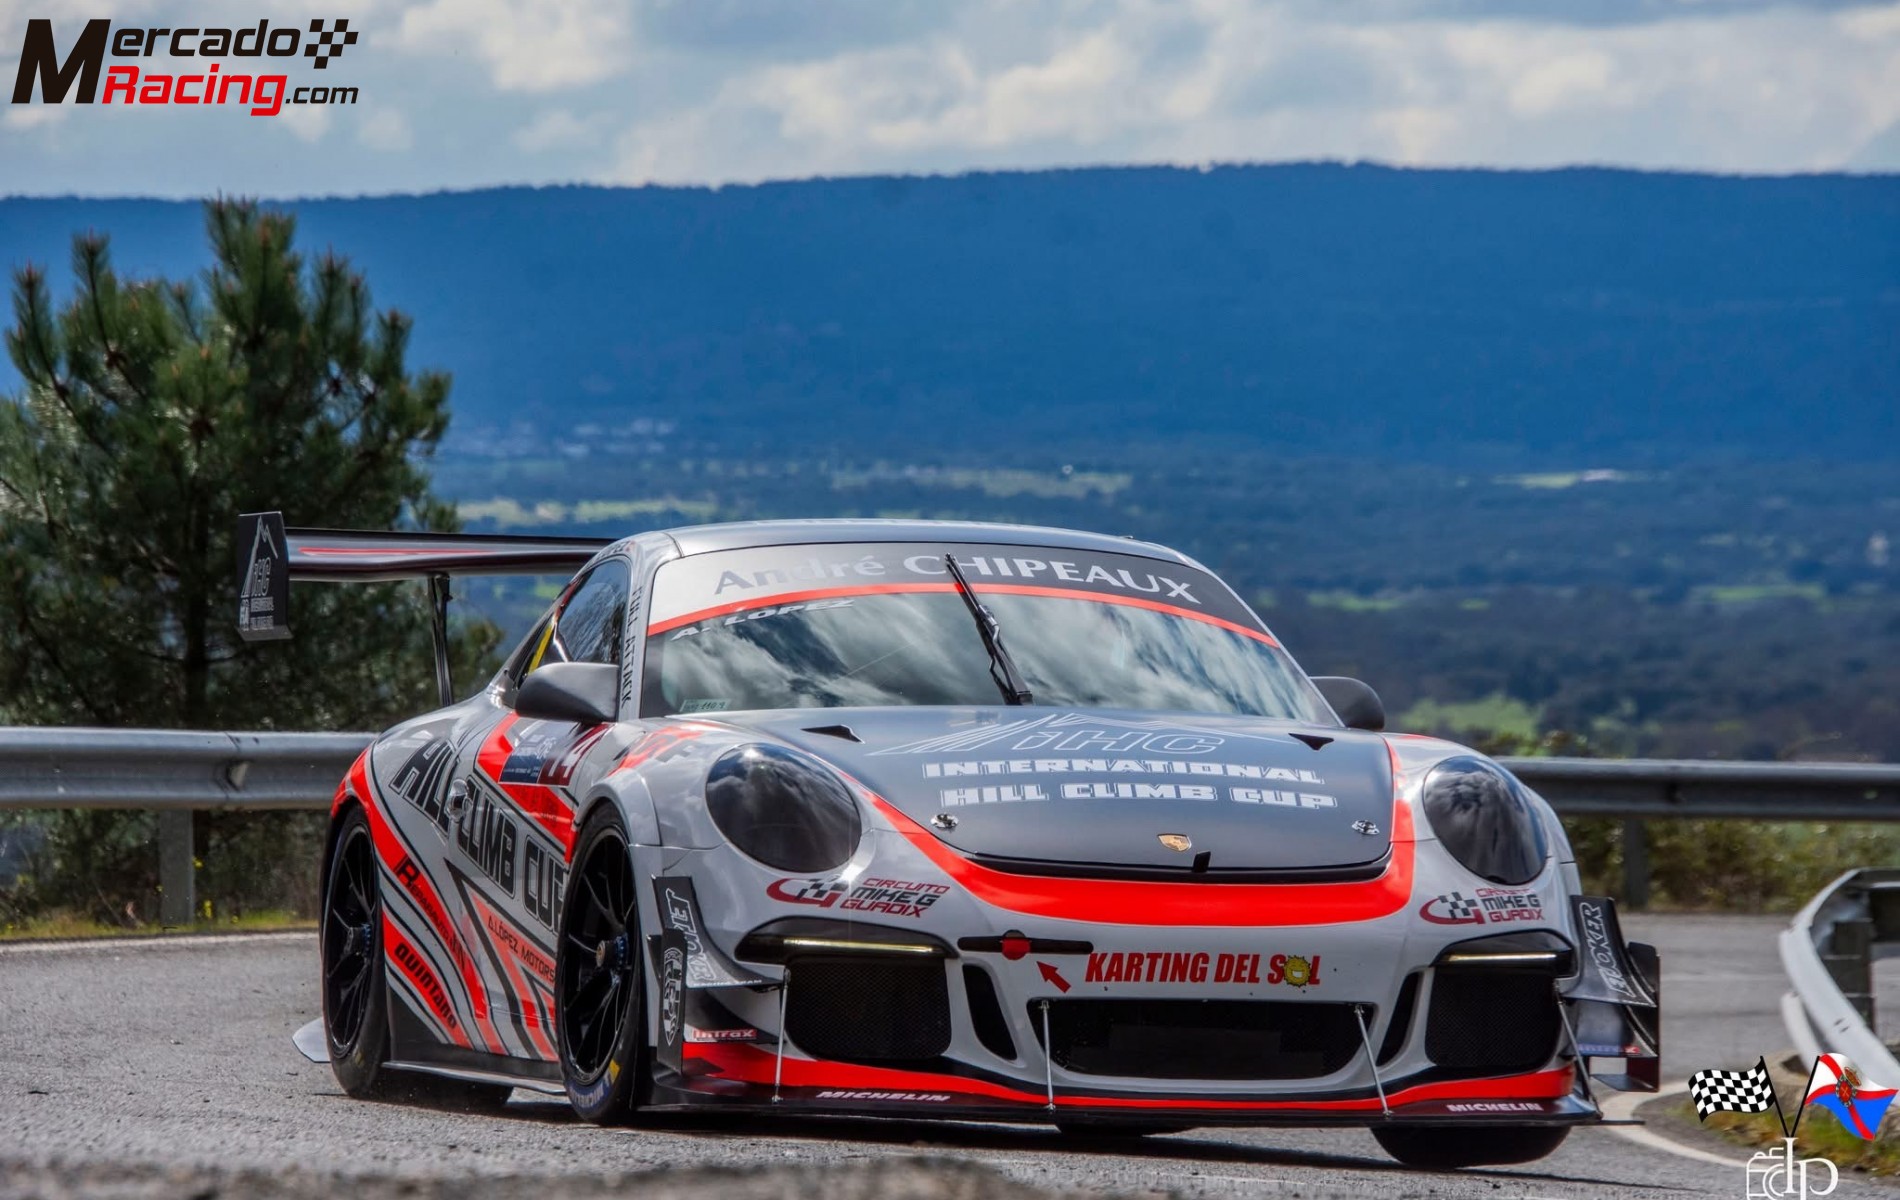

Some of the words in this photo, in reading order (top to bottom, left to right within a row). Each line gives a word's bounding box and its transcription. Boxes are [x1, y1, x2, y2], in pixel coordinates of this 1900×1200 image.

[714, 555, 887, 595] André
[903, 555, 1202, 605] CHIPEAUX
[621, 636, 636, 709] ATTACK
[923, 758, 1325, 785] INTERNATIONAL
[940, 783, 1049, 808] HILL
[1060, 782, 1217, 801] CLIMB
[1229, 786, 1337, 810] CUP
[457, 774, 518, 899] CLIMB
[863, 877, 951, 895] CIRCUITO
[840, 898, 928, 918] GUADIX
[1489, 908, 1545, 922] GUADIX
[1085, 951, 1210, 984] KARTING
[1213, 952, 1262, 985] DEL
[816, 1091, 951, 1102] MICHELIN
[1446, 1102, 1544, 1112] MICHELIN
